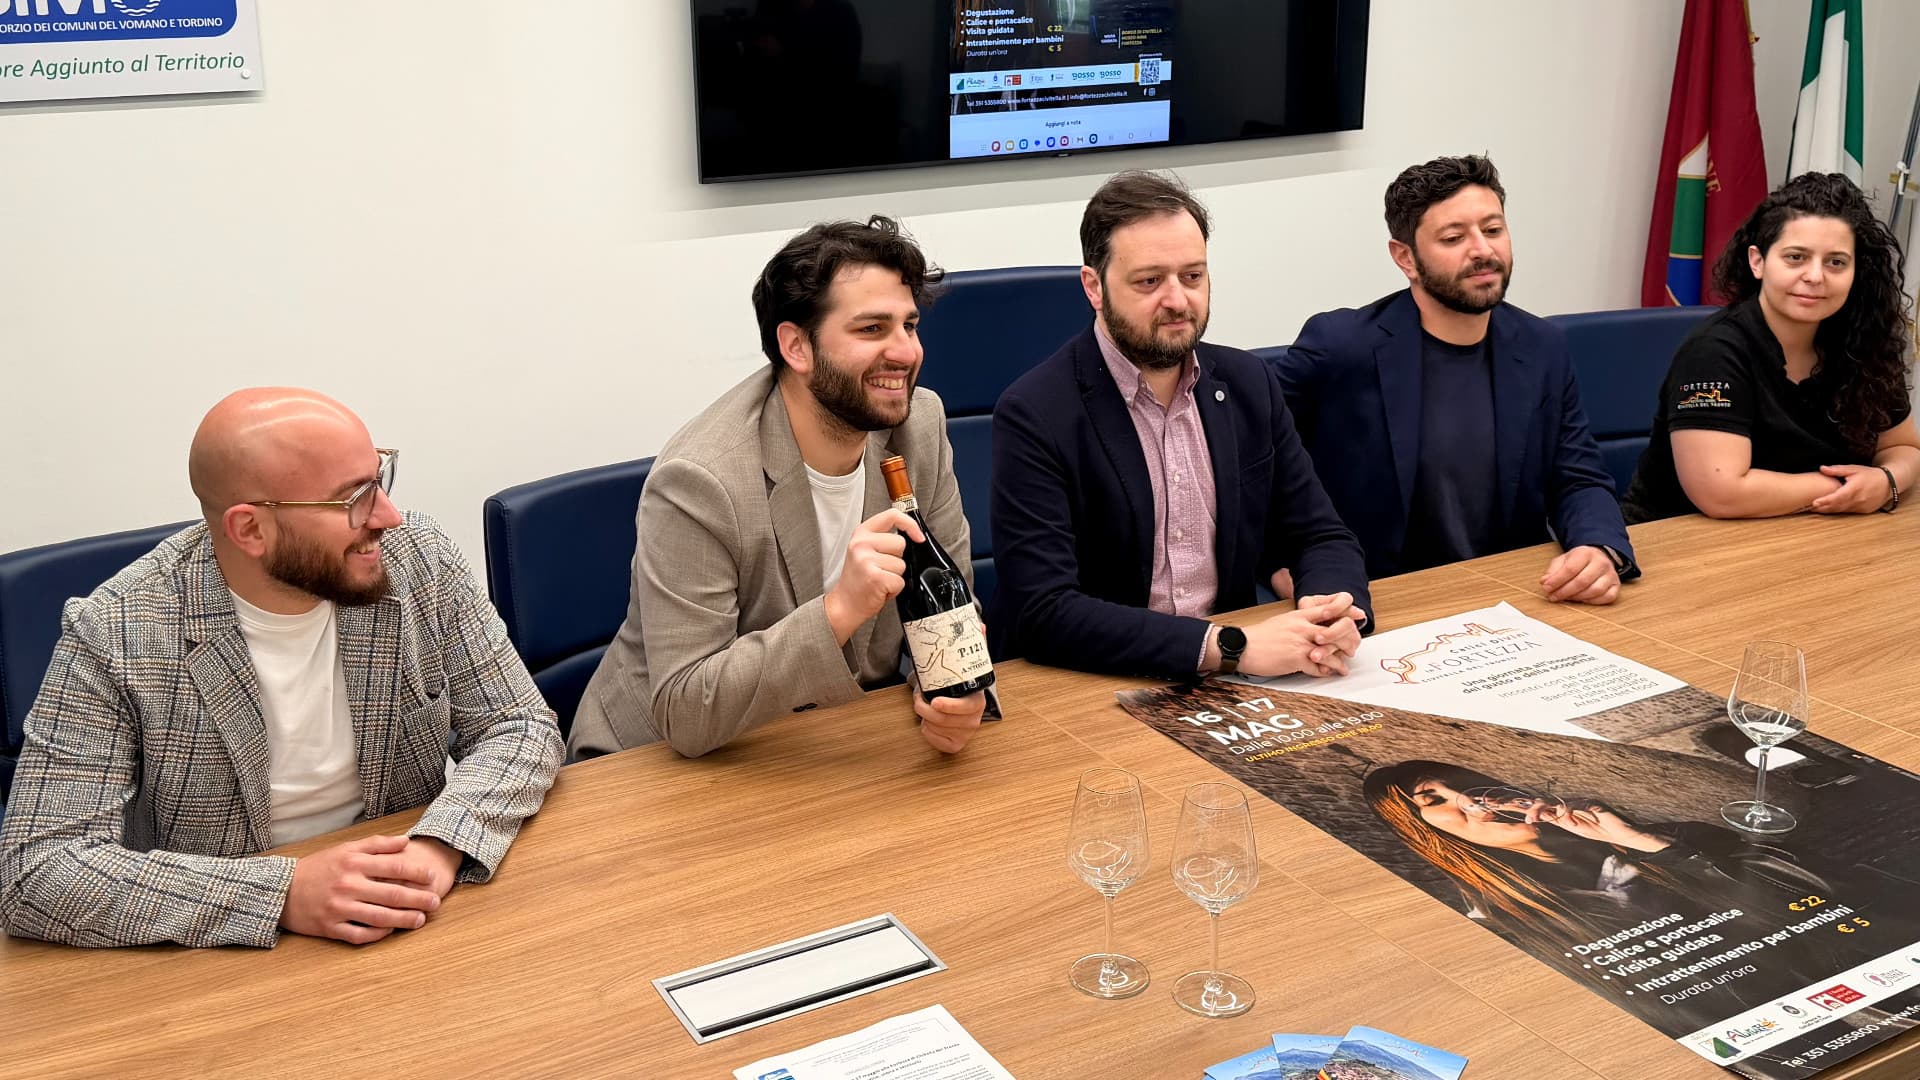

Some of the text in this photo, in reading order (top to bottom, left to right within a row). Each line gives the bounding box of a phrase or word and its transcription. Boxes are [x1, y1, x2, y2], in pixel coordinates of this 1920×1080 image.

[34, 22, 50, 32] DEI
[52, 21, 97, 31] COMUNI
[99, 20, 118, 30] DEL
[118, 19, 167, 29] VOMANO
[169, 18, 176, 28] E
[176, 17, 223, 27] TORDINO
[966, 8, 1015, 17] Degustazione
[966, 18, 987, 26] Calice
[995, 16, 1033, 26] portacalice
[966, 34, 1065, 47] Intrattenimento per bambini
[987, 26, 1015, 36] guidata
[0, 51, 245, 80] re Aggiunto al Territorio
[1679, 381, 1730, 392] FORTEZZA
[957, 642, 984, 658] P.121
[1428, 640, 1542, 671] FORTEZZA
[1461, 678, 1487, 687] Una
[1487, 666, 1533, 681] giornata
[1463, 686, 1481, 694] del
[1481, 679, 1514, 690] gusto
[1522, 668, 1550, 678] della
[1178, 697, 1275, 726] 16 17
[1206, 714, 1303, 745] MAG
[1229, 711, 1384, 755] Dalle 10.00 alle 19.00
[1245, 749, 1285, 762] ULTIMO
[1285, 736, 1335, 752] INGRESSO
[1788, 895, 1826, 912] € 22
[1572, 913, 1684, 955] Degustazione
[1593, 908, 1744, 966] Calice e portacalice
[1837, 916, 1871, 934] € 5
[1608, 932, 1724, 977] Visita guidata
[1634, 904, 1854, 992] Intrattenimento per bambini
[1659, 963, 1758, 1005] Durata un'ora
[1780, 1056, 1808, 1068] Tel
[1801, 1047, 1829, 1060] 351
[1823, 1024, 1880, 1050] 5355800
